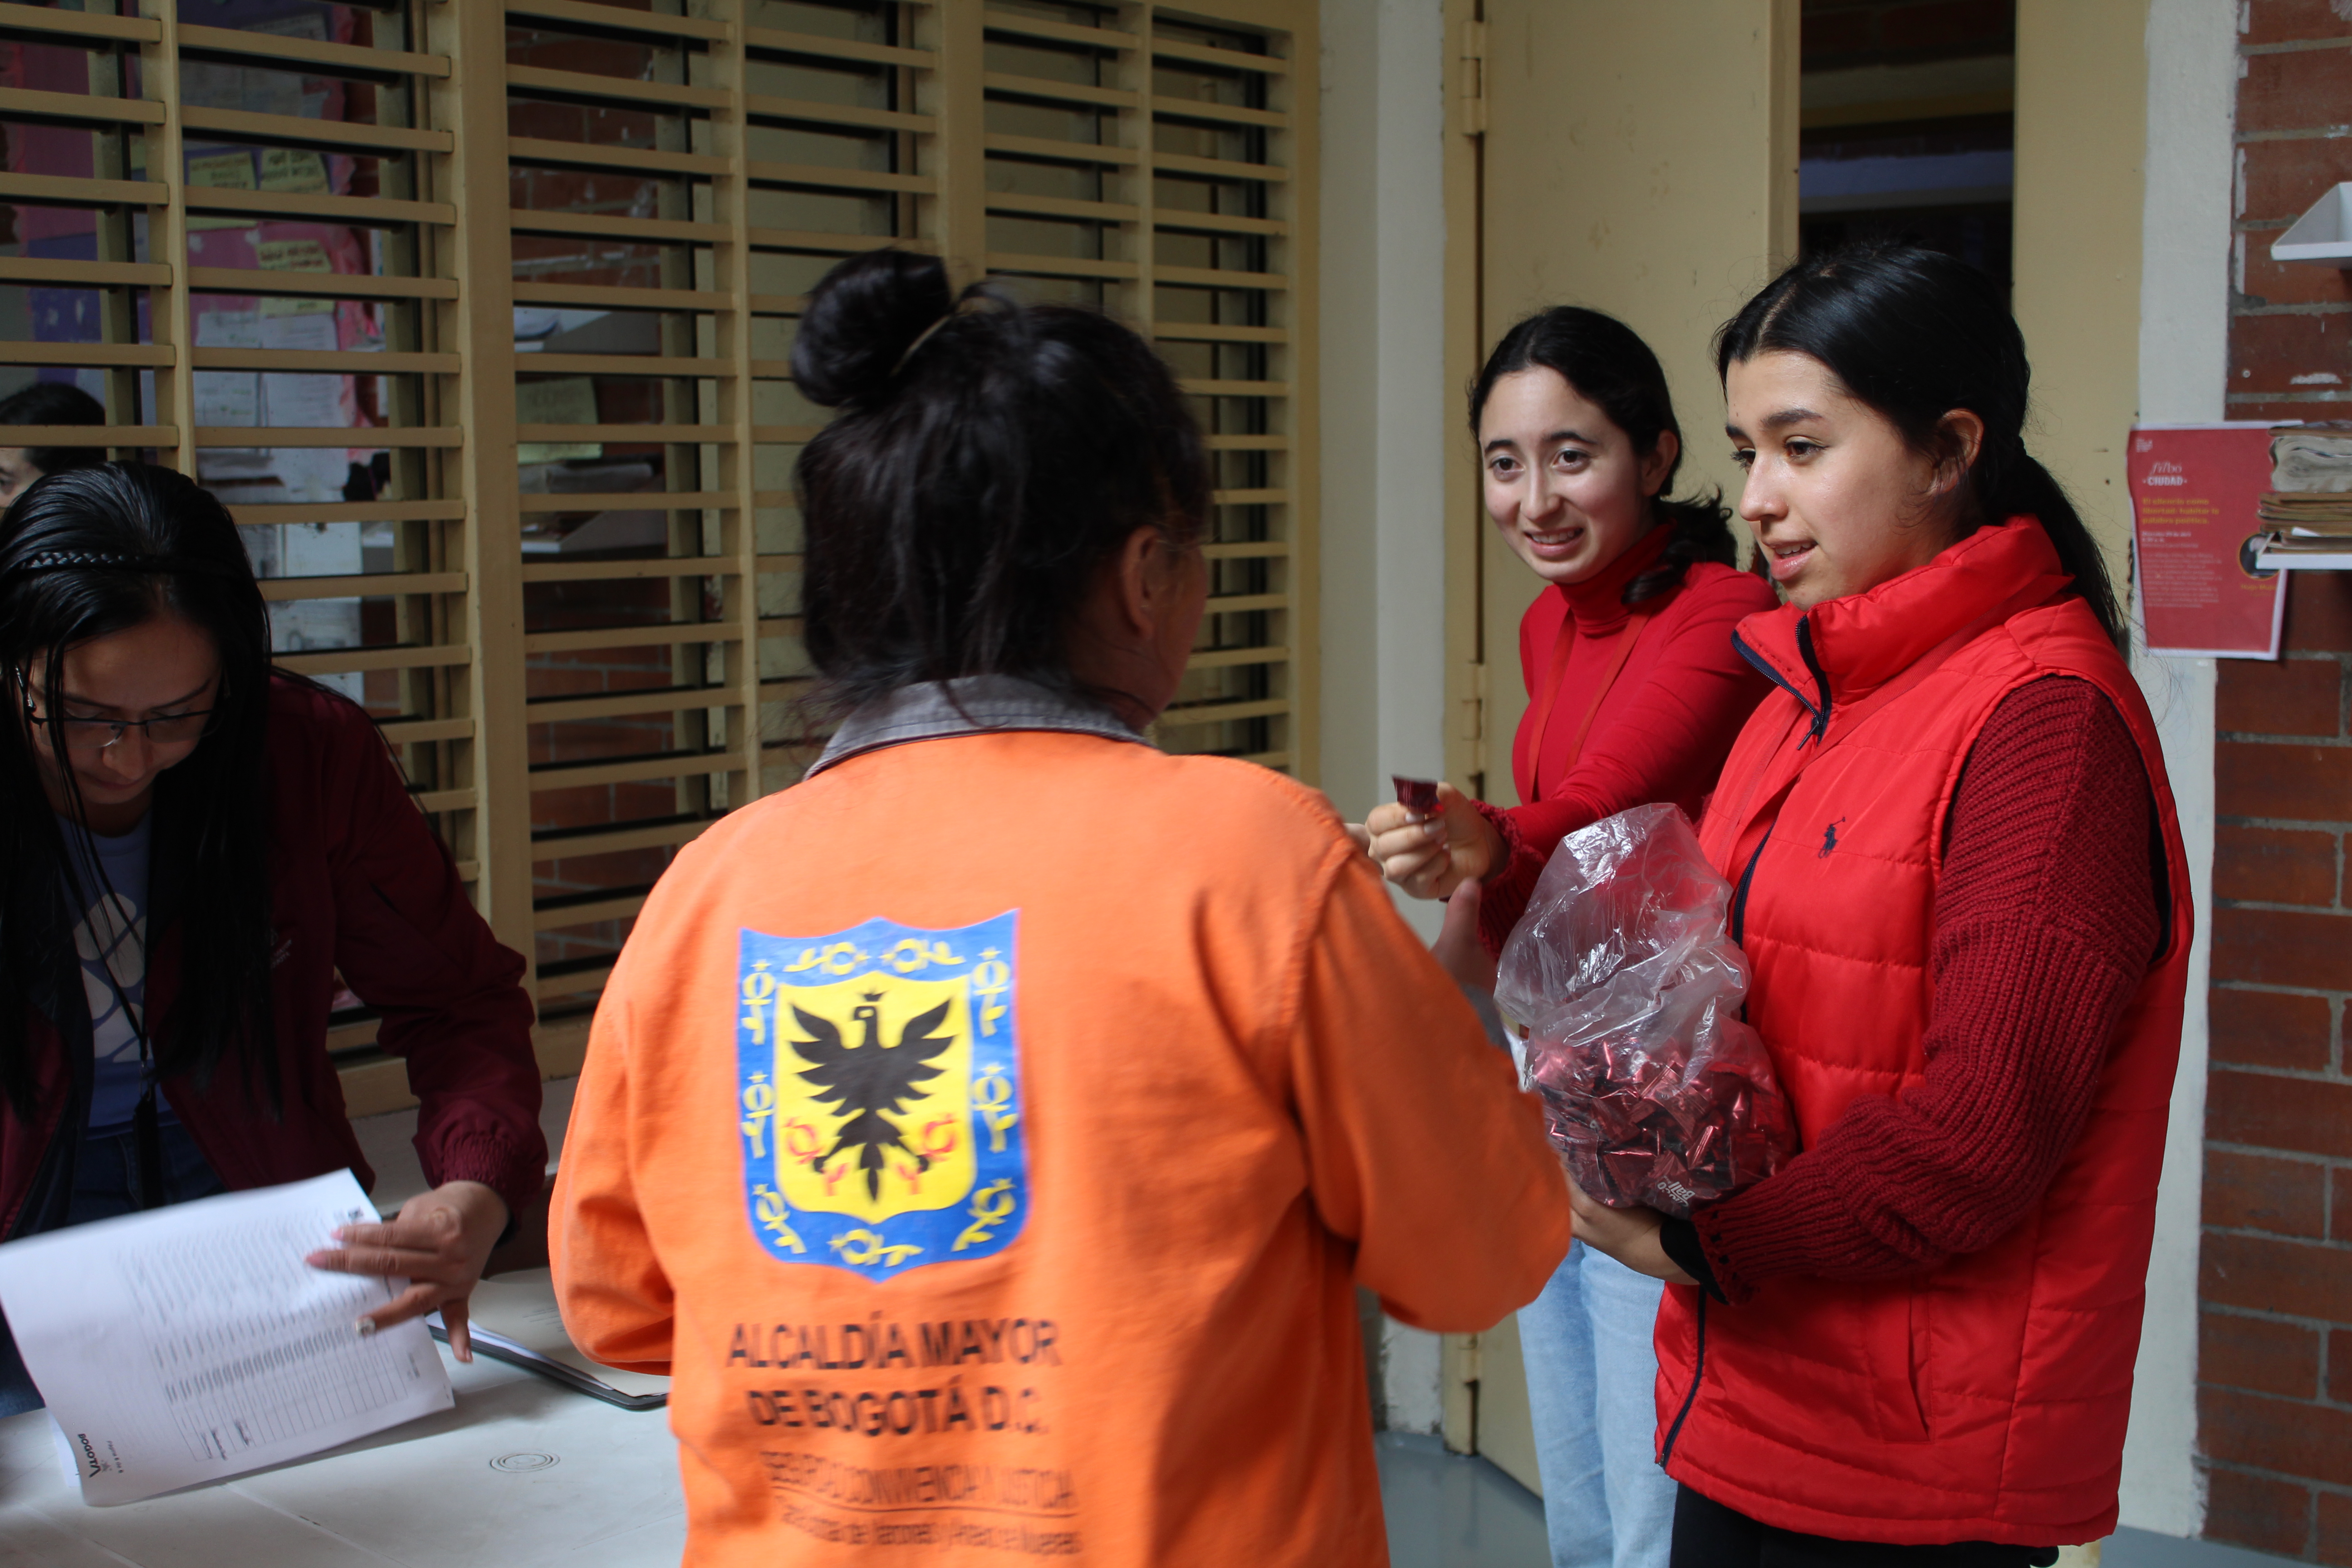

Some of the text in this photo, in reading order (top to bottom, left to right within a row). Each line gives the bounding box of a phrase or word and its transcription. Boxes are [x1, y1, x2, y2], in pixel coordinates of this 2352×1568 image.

[1668, 1181, 1696, 1200] Ball
[726, 1310, 1063, 1369] ALCALDÍA MAYOR
[745, 1390, 803, 1427] DE
[804, 1373, 976, 1436] BOGOTÁ
